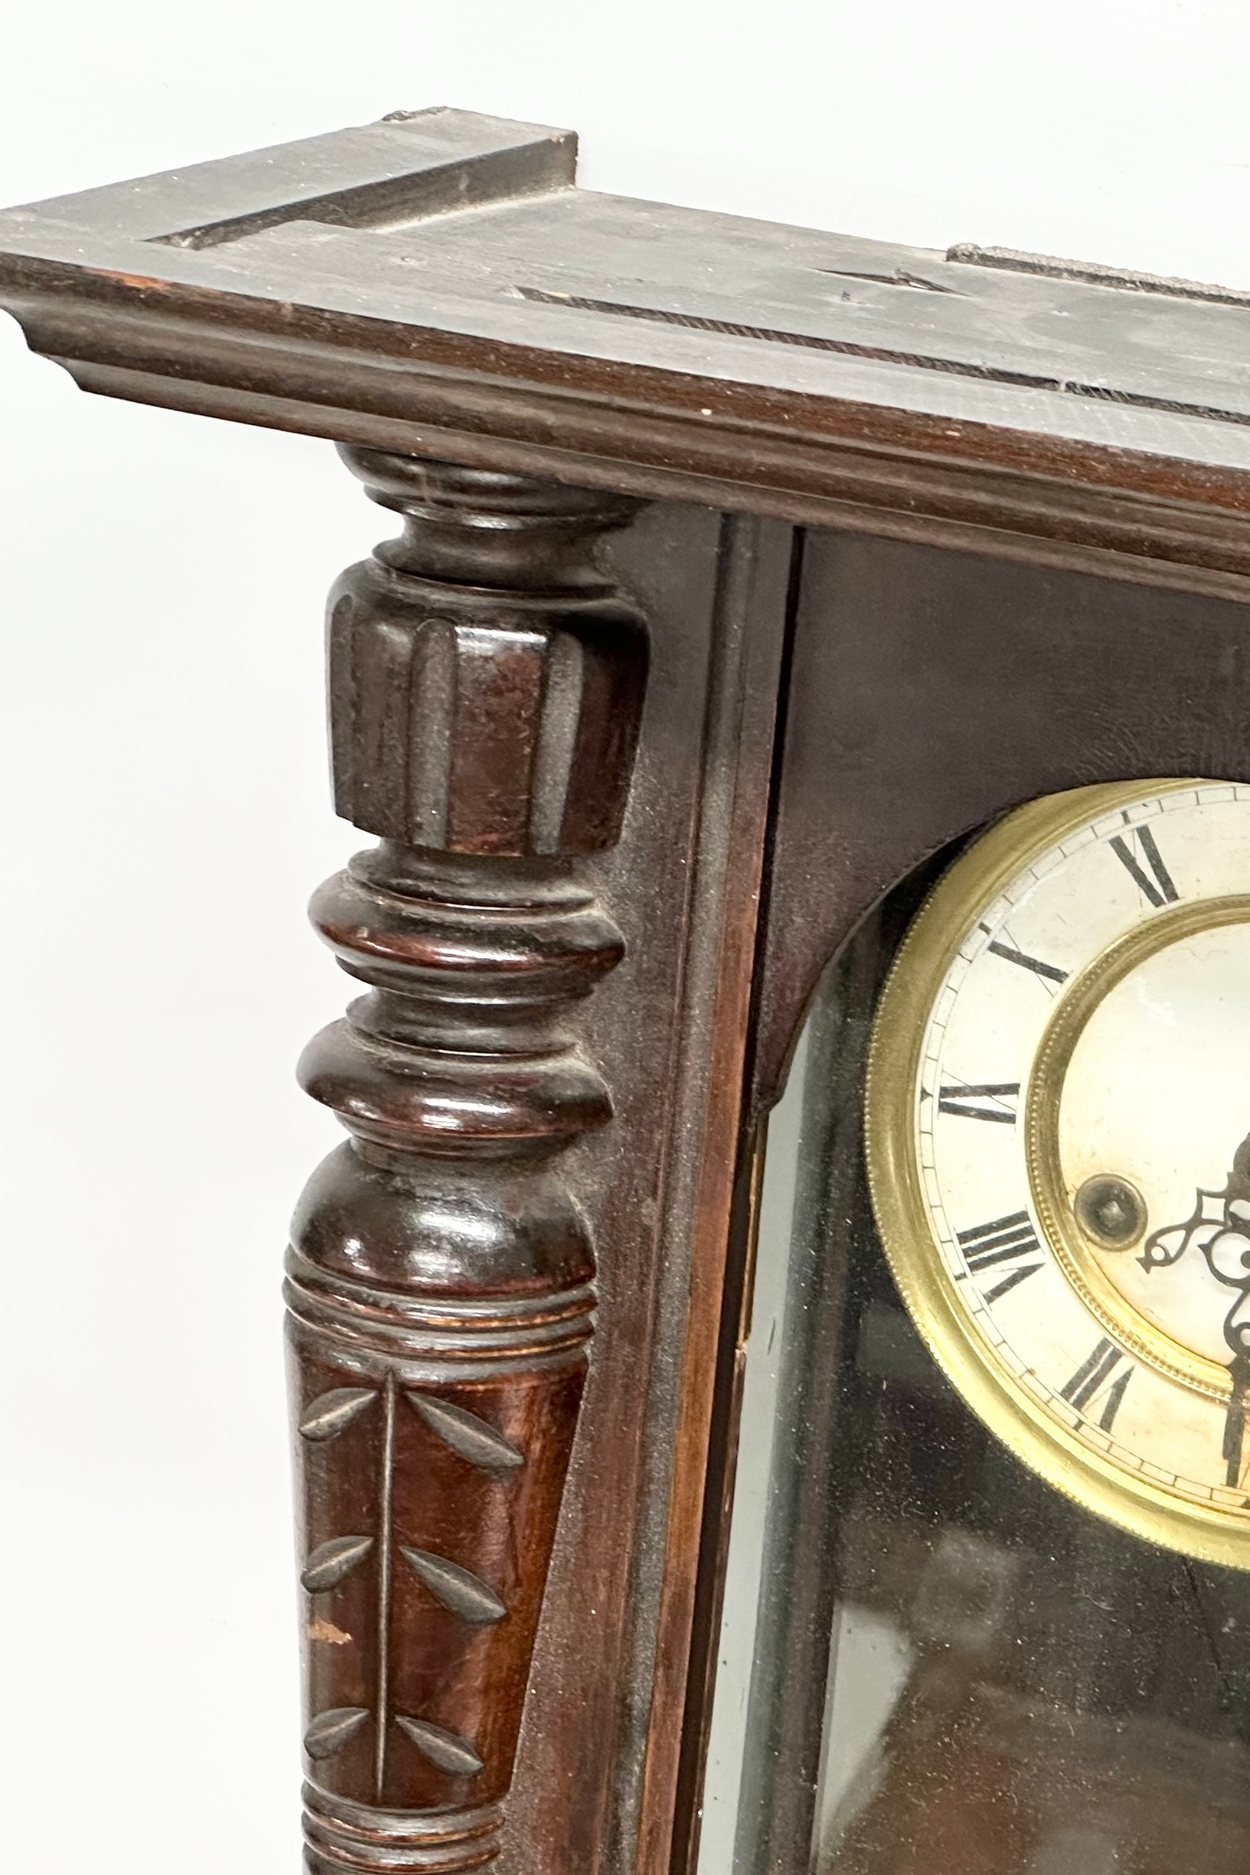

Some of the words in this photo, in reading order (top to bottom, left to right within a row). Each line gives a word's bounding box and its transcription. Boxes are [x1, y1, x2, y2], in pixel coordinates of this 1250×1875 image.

[1109, 824, 1181, 908] XI
[987, 926, 1070, 997] X
[938, 1070, 1022, 1125] IX
[953, 1209, 1047, 1305] VIII
[1058, 1336, 1136, 1436] VII
